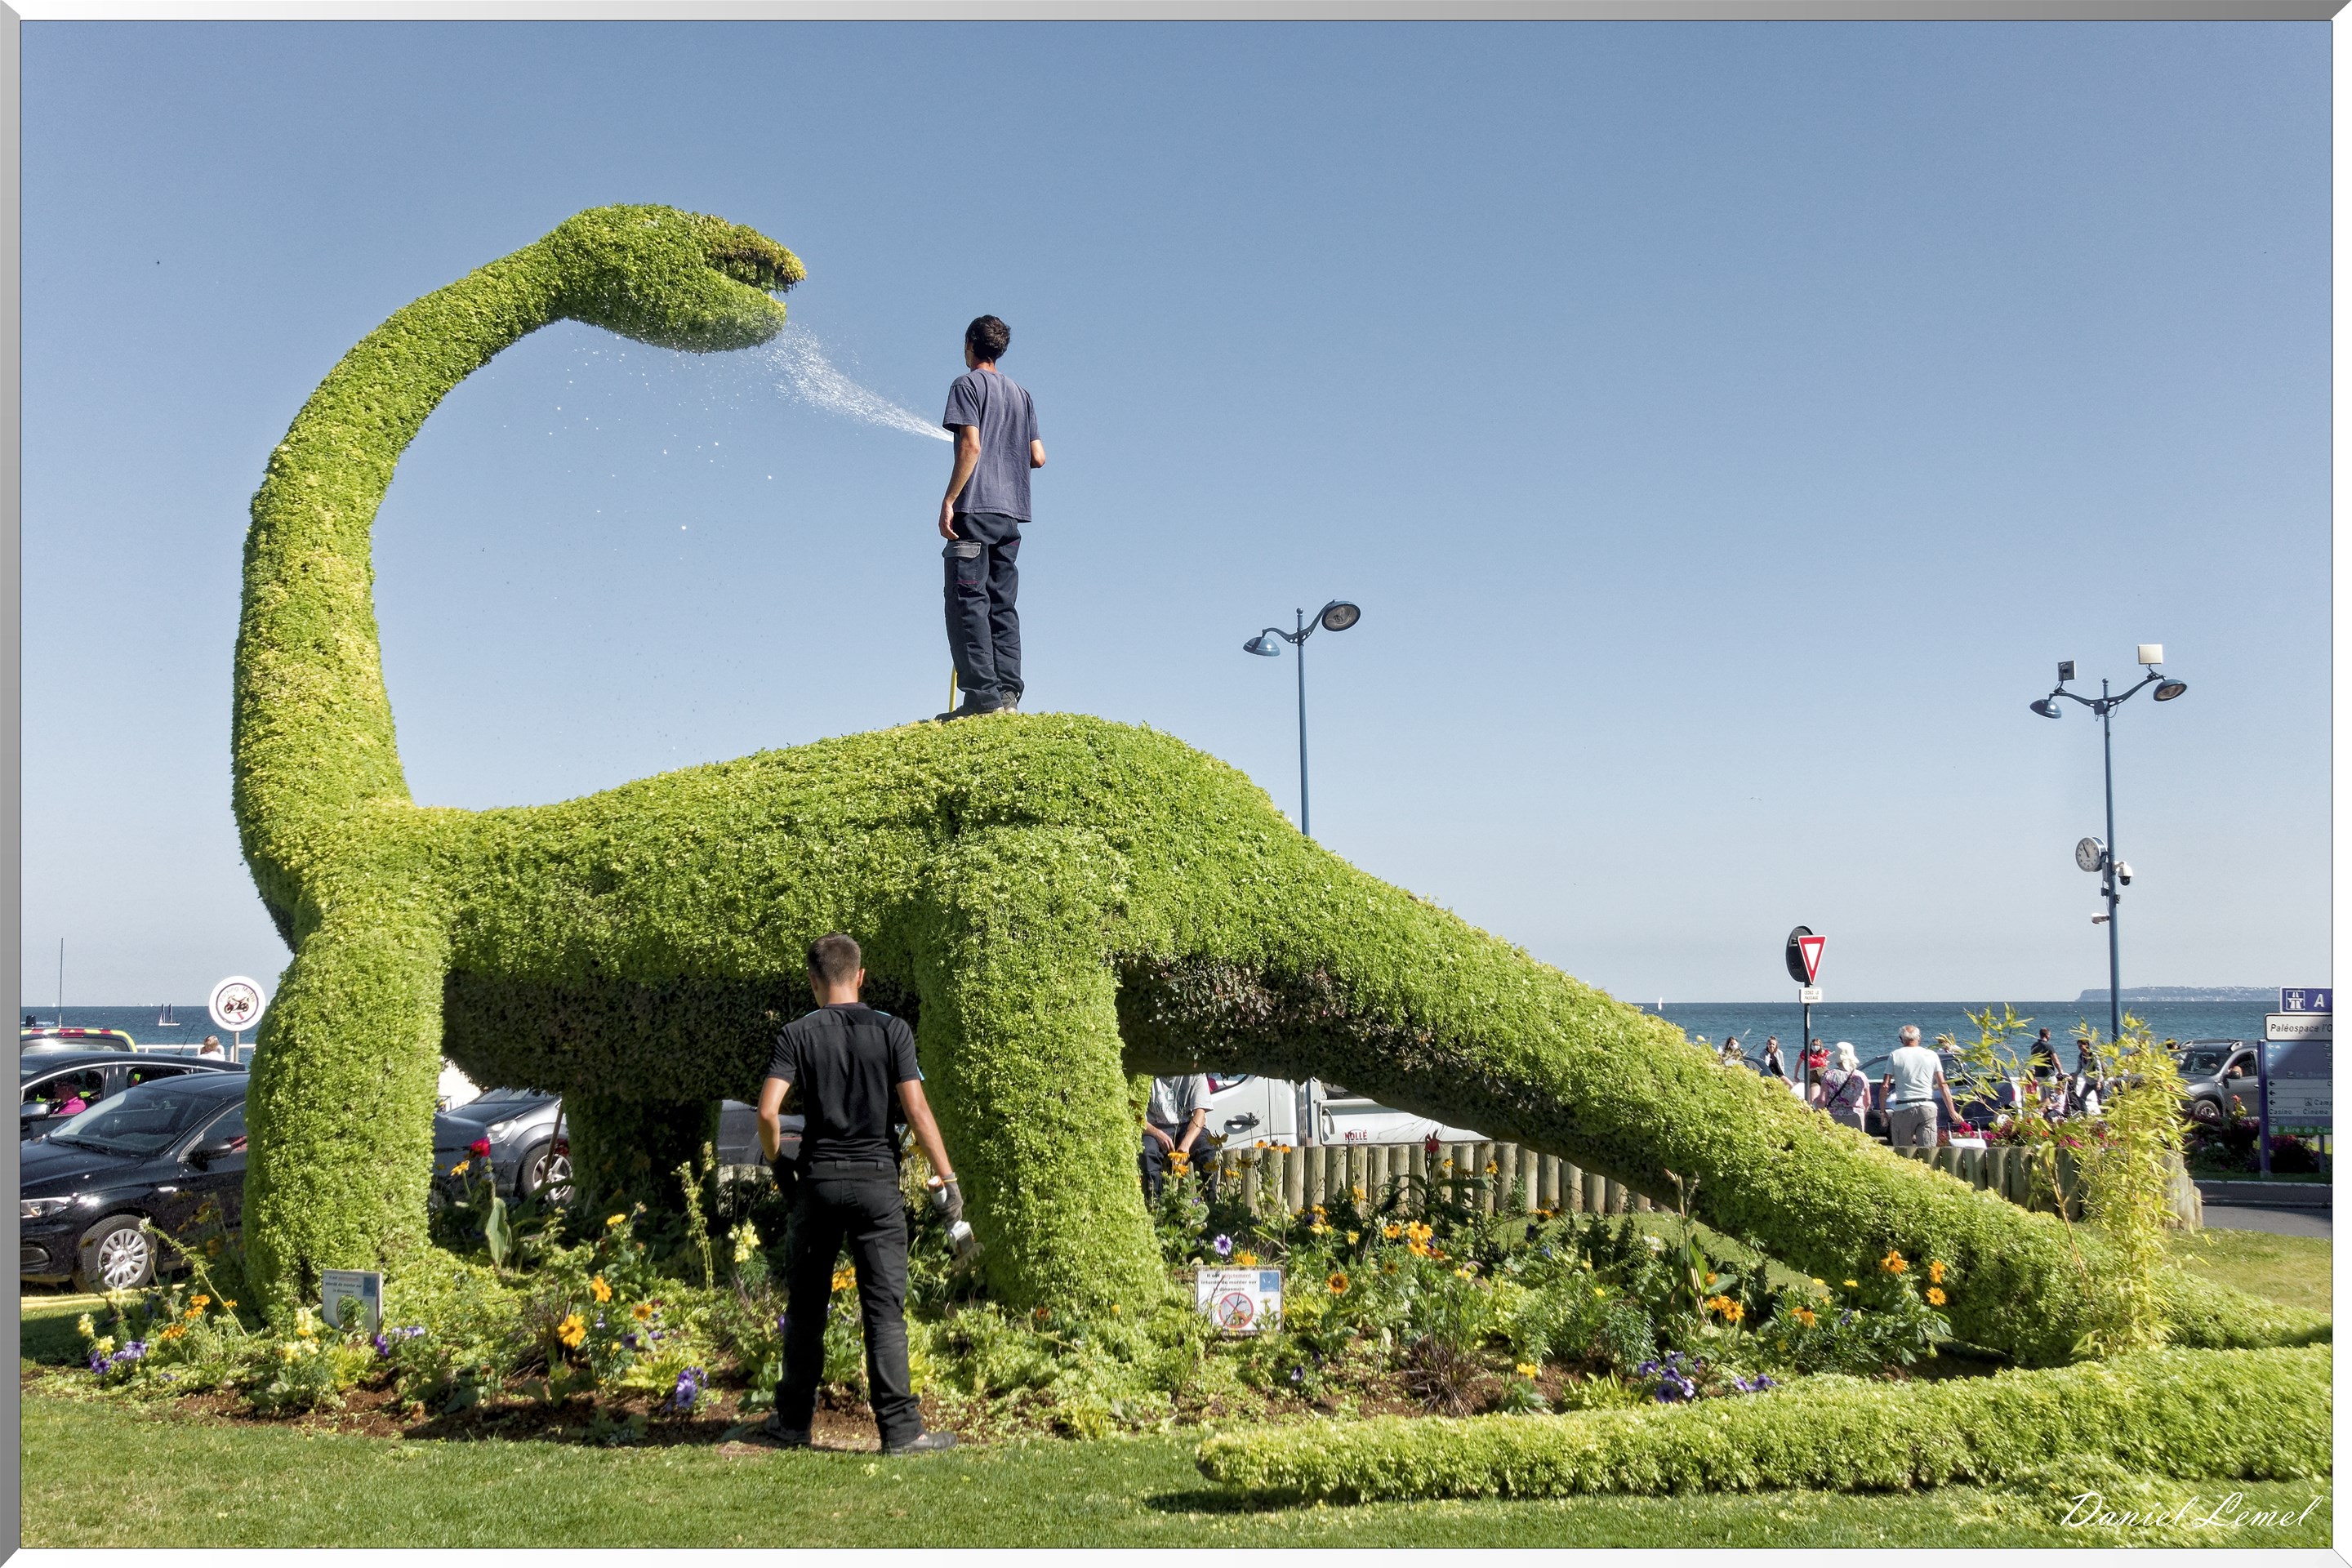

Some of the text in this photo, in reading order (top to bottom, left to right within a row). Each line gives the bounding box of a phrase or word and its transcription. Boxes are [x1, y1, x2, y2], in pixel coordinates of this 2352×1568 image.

[219, 987, 256, 1003] Parking Motos
[2314, 994, 2325, 1008] A
[2270, 1023, 2319, 1035] Paléospace
